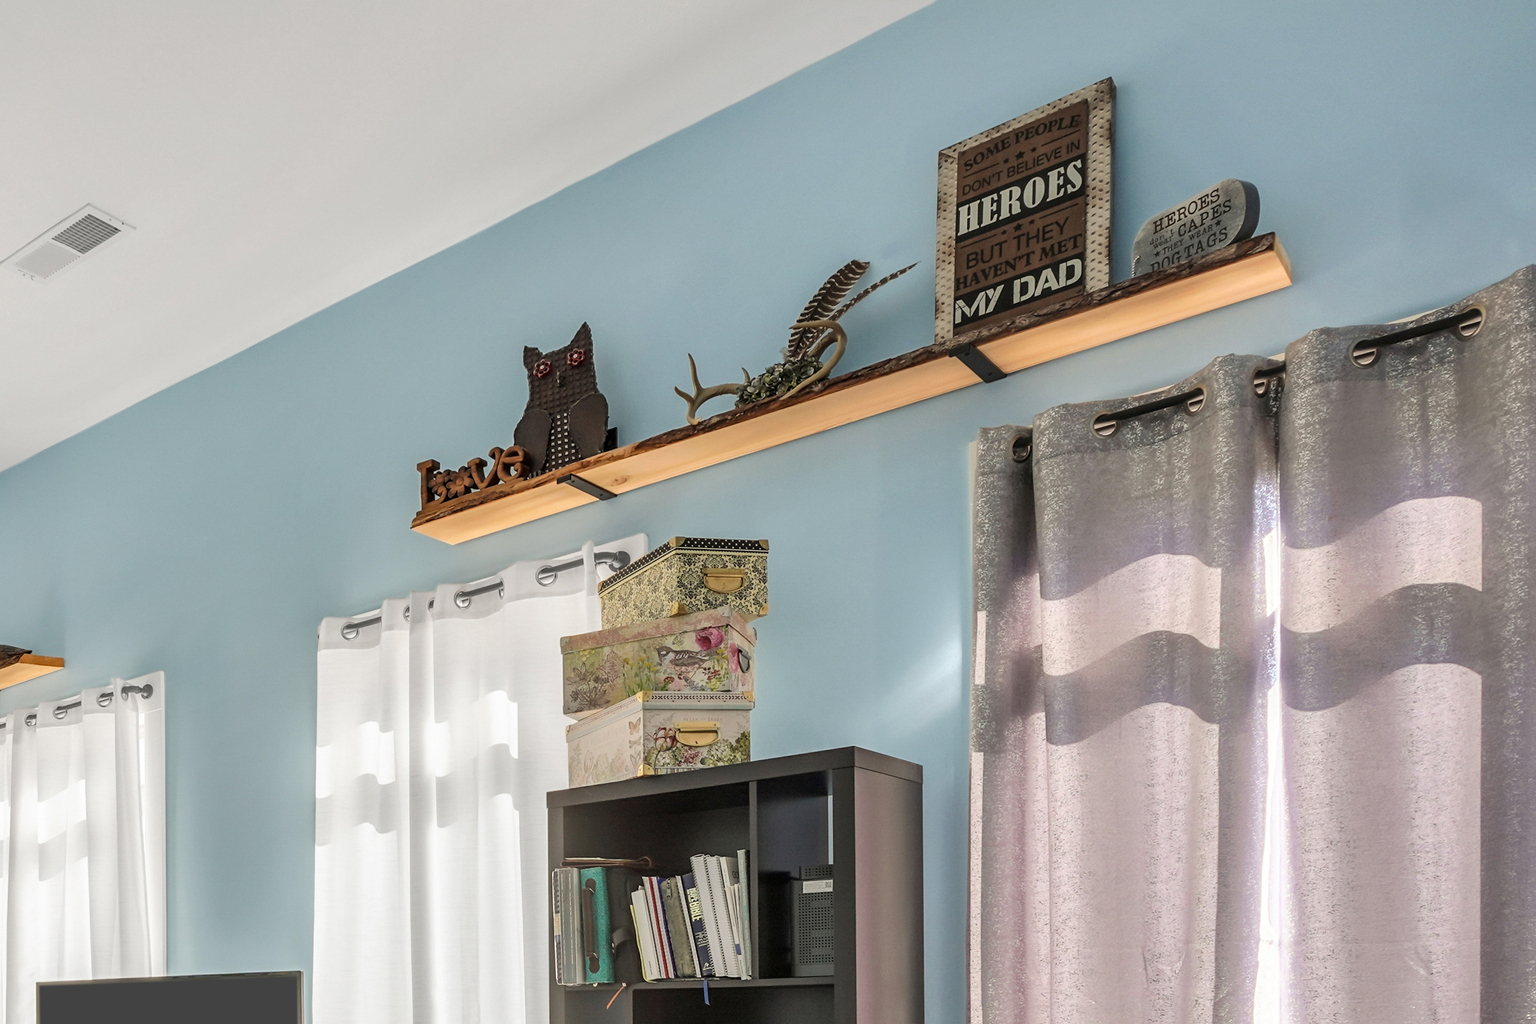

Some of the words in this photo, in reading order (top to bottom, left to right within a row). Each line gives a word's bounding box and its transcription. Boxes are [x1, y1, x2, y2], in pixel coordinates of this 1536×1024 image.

[962, 171, 1003, 197] DON'T
[1006, 149, 1063, 177] BELIEVE
[1066, 138, 1082, 156] IN
[963, 136, 1011, 173] SOME
[1014, 114, 1082, 143] PEOPLE
[957, 159, 1084, 237] HEROES
[1153, 188, 1221, 235] HEROES
[1178, 199, 1232, 237] CAPES
[955, 250, 1037, 292] HAVEN'T
[1039, 233, 1083, 262] MET
[966, 239, 1009, 270] BUT
[1013, 217, 1069, 251] THEY
[1150, 251, 1182, 272] DOG
[1184, 227, 1228, 259] TAGS
[1162, 238, 1184, 255] THEY
[1188, 224, 1213, 242] WEAR
[954, 284, 1006, 325] MY
[1013, 257, 1083, 305] DAD
